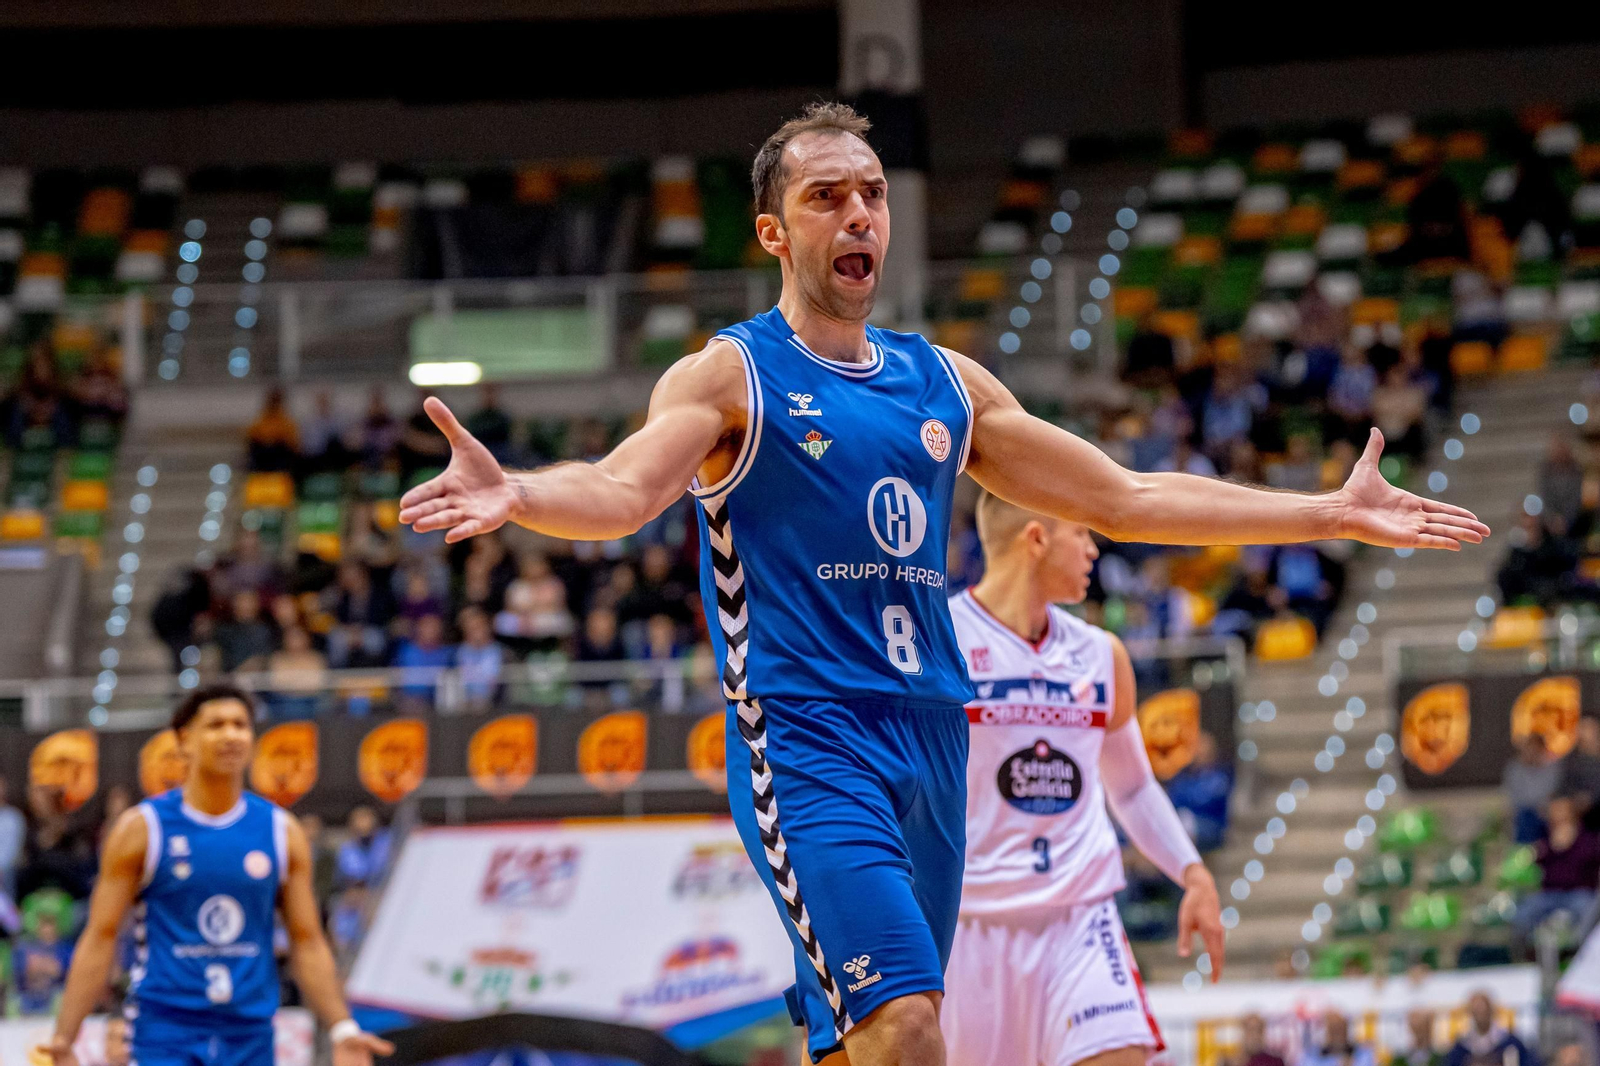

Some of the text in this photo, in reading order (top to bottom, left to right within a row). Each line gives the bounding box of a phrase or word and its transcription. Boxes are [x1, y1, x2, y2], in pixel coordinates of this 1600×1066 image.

[789, 407, 823, 417] hummel
[816, 563, 945, 590] GRUPO HEREDA
[882, 604, 923, 676] 8
[1032, 837, 1051, 874] 3
[204, 963, 233, 1004] 3
[847, 970, 882, 993] hummel
